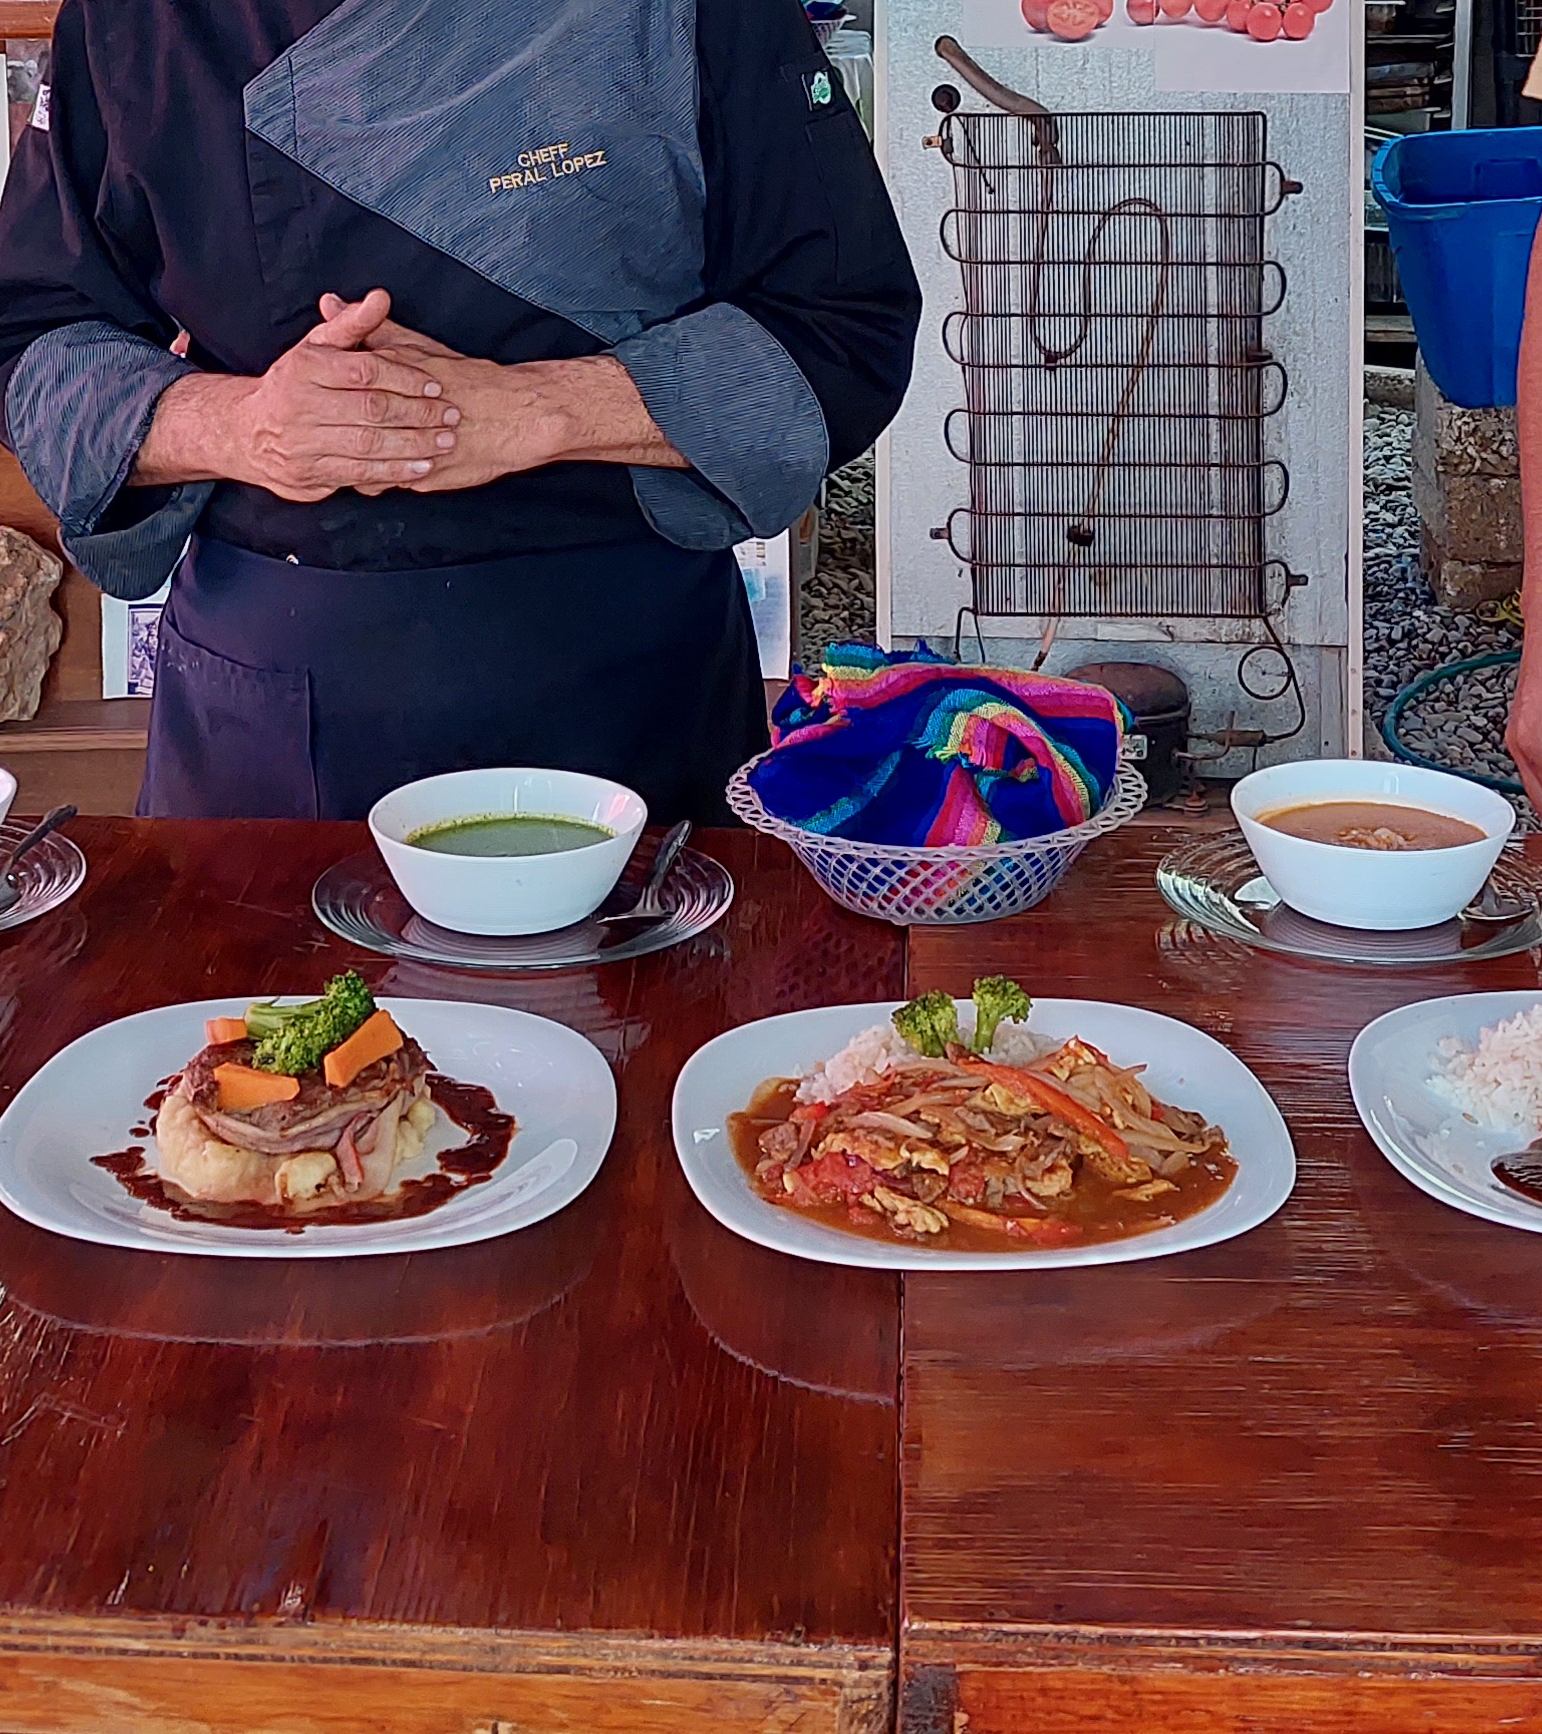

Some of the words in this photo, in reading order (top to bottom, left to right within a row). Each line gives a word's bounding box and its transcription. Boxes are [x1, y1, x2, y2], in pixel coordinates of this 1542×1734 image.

[517, 142, 569, 167] CHEFF
[489, 167, 547, 194] PERAL
[551, 150, 608, 178] LOPEZ
